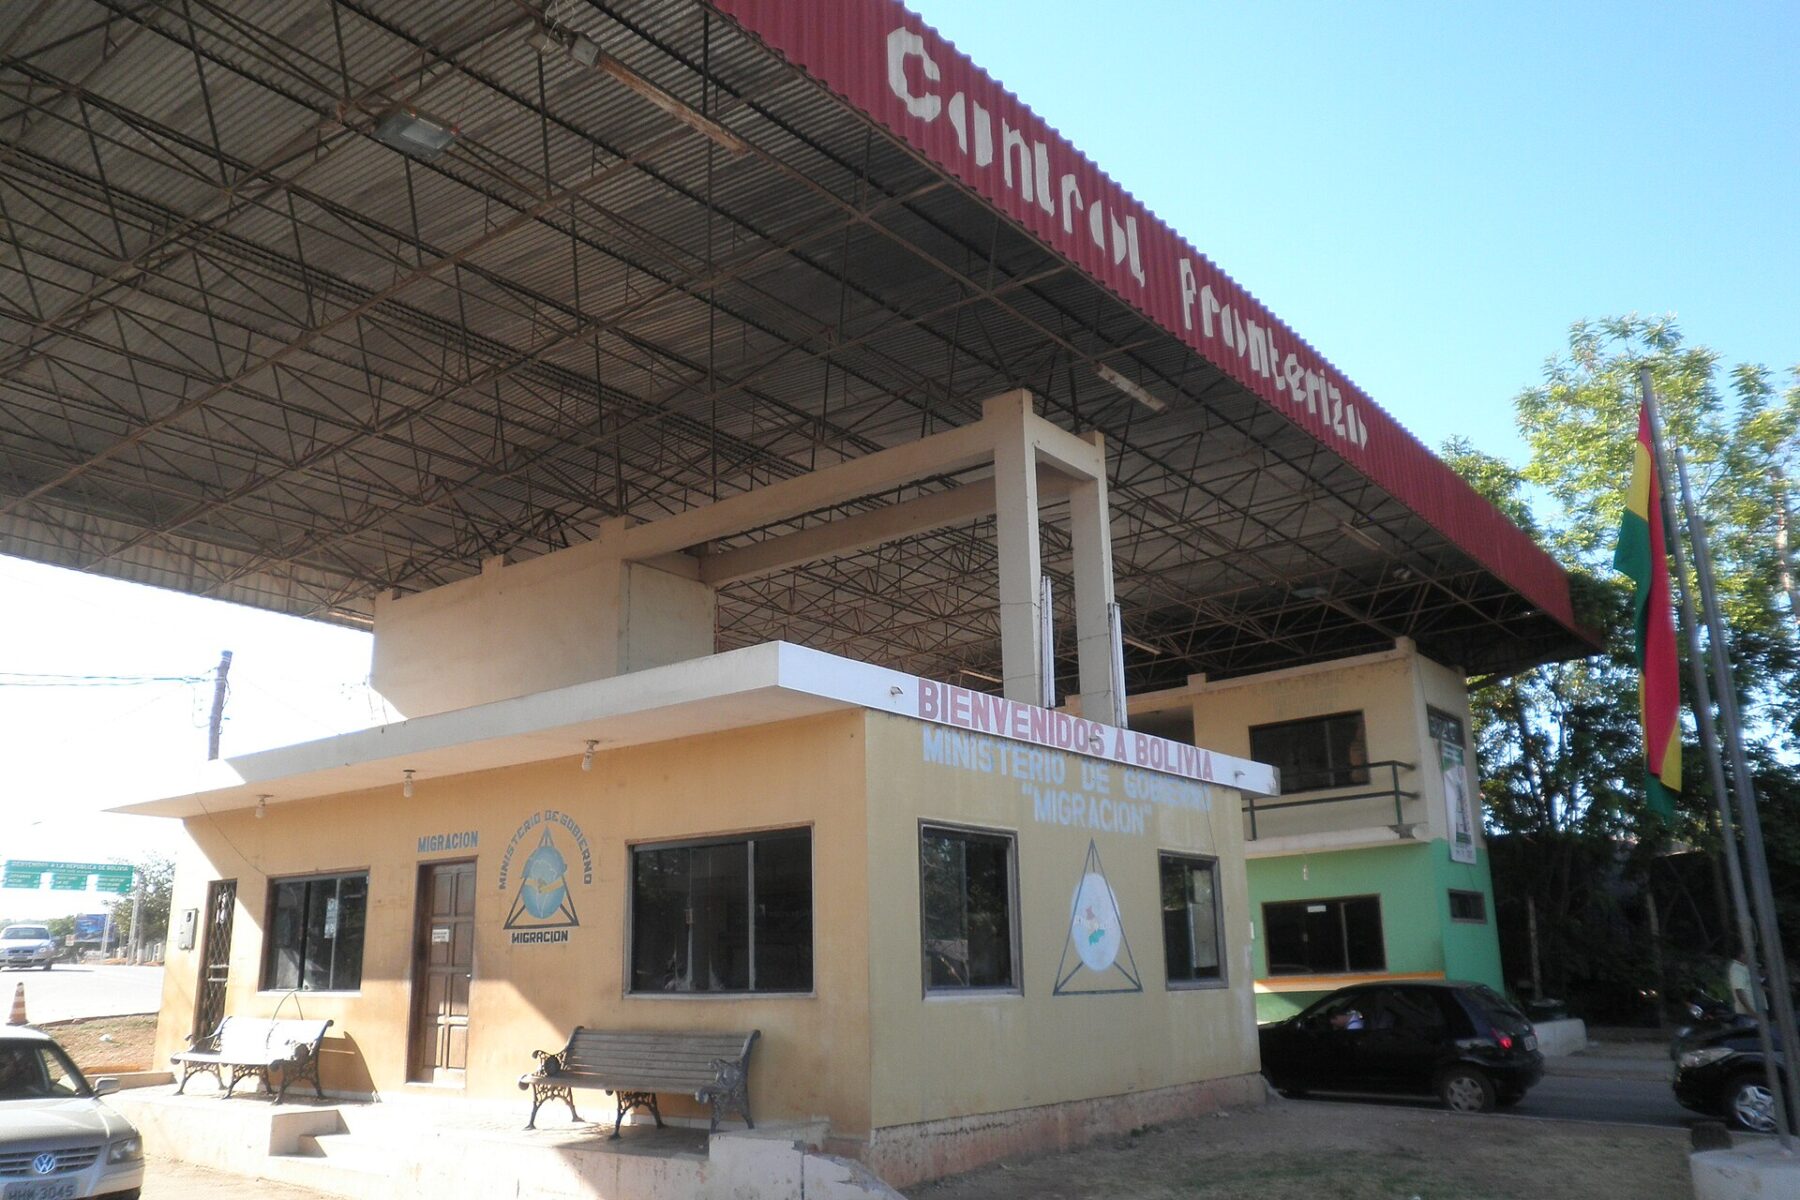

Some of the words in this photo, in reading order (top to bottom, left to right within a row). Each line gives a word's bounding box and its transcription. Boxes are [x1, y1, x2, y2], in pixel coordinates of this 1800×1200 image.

[887, 27, 1146, 288] Control
[917, 677, 1105, 758] BIENVENIDOS
[1114, 726, 1128, 762] A
[1135, 732, 1215, 782] BOLIVIA
[922, 726, 1066, 783] MINISTERIO
[1081, 762, 1110, 795] DE
[1124, 770, 1213, 812] GOBEO
[417, 831, 479, 853] MIGRACION
[499, 812, 541, 890] MINISTERIO
[544, 810, 560, 822] DE
[559, 812, 593, 885] GOBIERNO
[511, 930, 569, 944] MIGRACION
